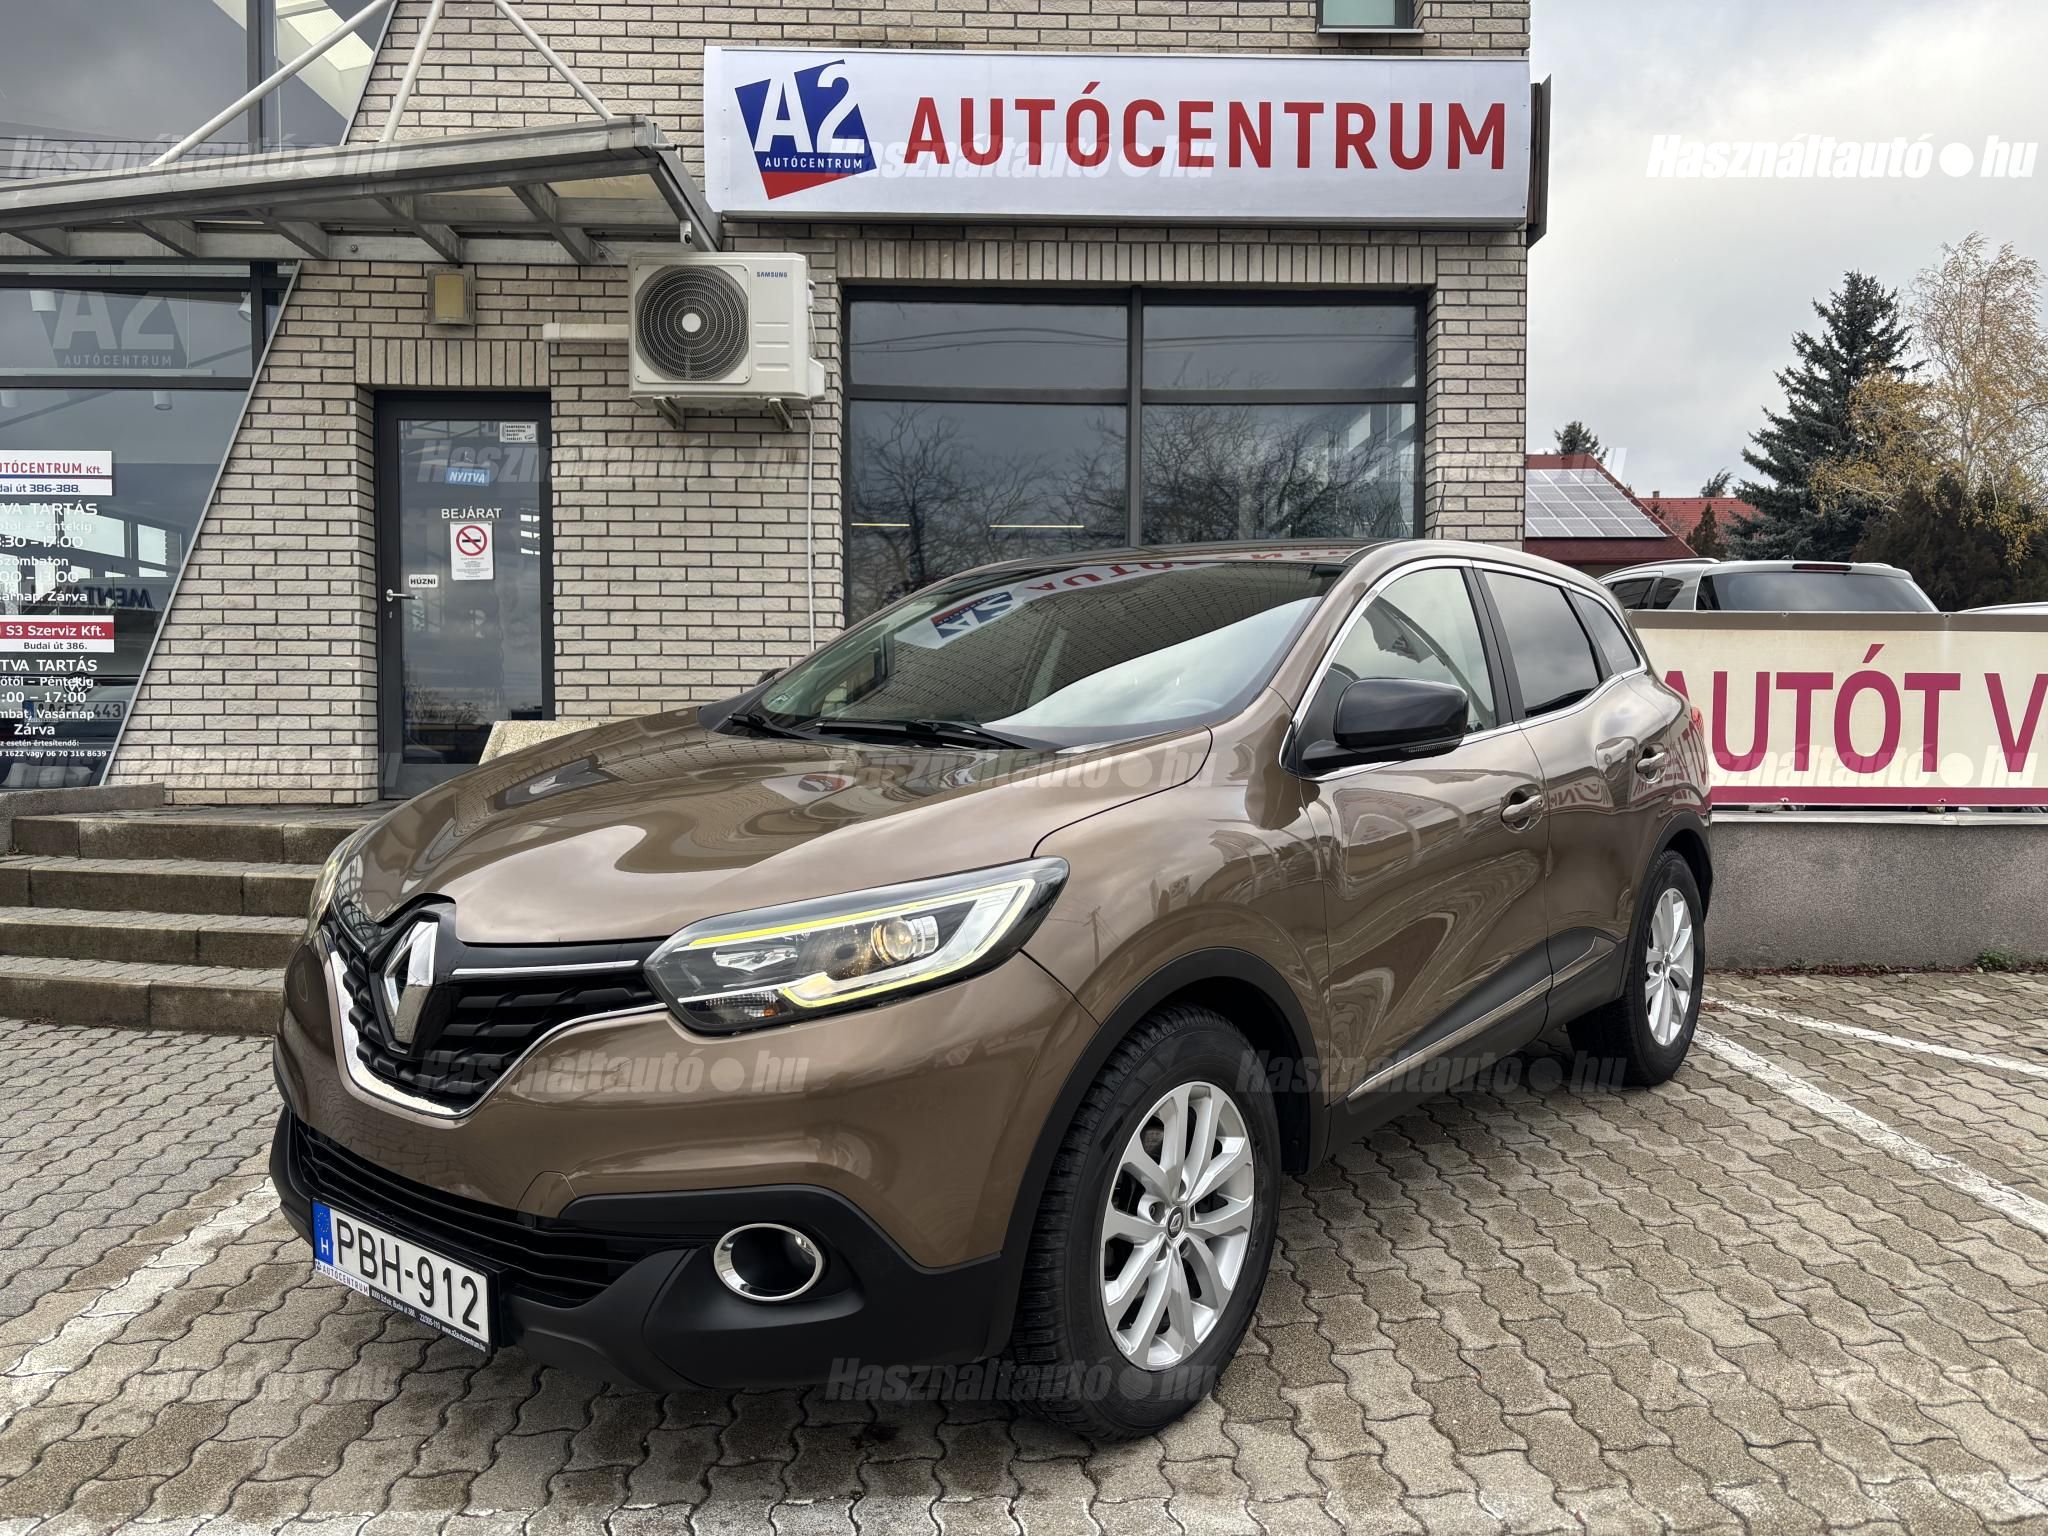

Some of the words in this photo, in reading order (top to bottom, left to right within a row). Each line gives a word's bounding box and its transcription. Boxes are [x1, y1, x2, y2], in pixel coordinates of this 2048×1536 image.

[754, 63, 865, 153] A2
[903, 81, 1505, 170] AUTÓCENTRUM
[765, 156, 863, 169] AUTÓCENTRUM
[64, 353, 172, 366] AUTÓCENTRUM
[0, 459, 82, 474] TÓCENTRUM
[86, 466, 103, 474] Kft.
[449, 470, 486, 484] NYITVA
[29, 484, 81, 493] 386-388.
[29, 499, 98, 516] TARTÁS
[441, 505, 503, 519] BEJÁRAT
[410, 575, 436, 585] HÚZNI
[47, 588, 88, 602] Zárva
[6, 625, 23, 636] S3
[28, 625, 77, 636] Szerviz
[81, 625, 106, 636] Kft.
[23, 642, 51, 650] Budai
[53, 641, 63, 650] út
[66, 642, 88, 650] 386.
[36, 656, 98, 672] TARTÁS
[40, 675, 94, 689] Péntekig
[44, 691, 87, 703] 17:00
[36, 707, 95, 721] Vasárnap
[1665, 644, 1961, 773] UTÓT
[13, 722, 56, 736] Zárva
[5, 750, 24, 758] 1622
[26, 751, 44, 759] vagy
[46, 750, 57, 758] 06
[58, 750, 68, 758] 70
[70, 750, 85, 758] 316
[86, 750, 107, 758] 8639
[320, 1238, 330, 1257] H
[336, 1217, 480, 1332] PBH-912
